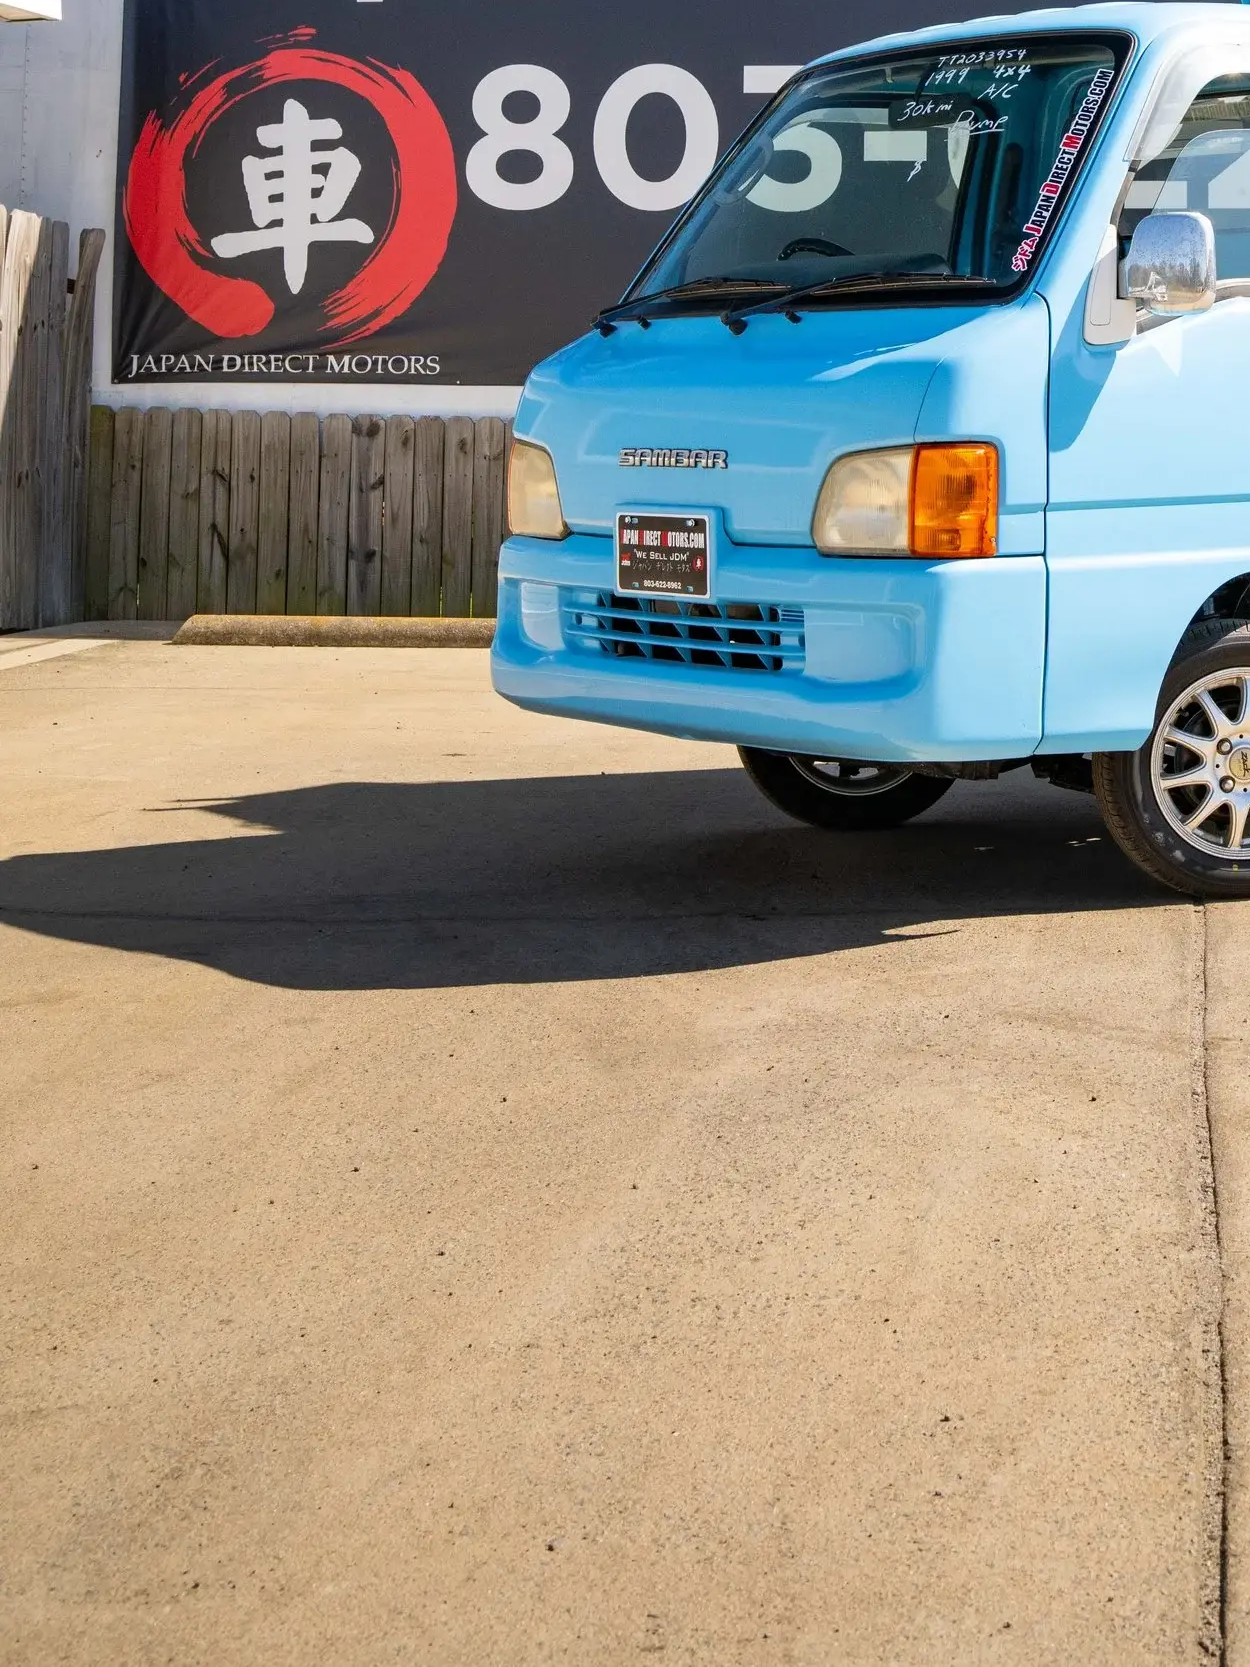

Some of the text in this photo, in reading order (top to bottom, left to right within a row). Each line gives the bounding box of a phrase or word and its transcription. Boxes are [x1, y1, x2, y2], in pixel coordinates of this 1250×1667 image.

[925, 67, 971, 86] 1999
[977, 83, 1019, 100] A/C
[211, 98, 374, 294] 車
[128, 354, 440, 378] JAPAN DIRECT MOTORS
[618, 448, 728, 469] SAMBAR
